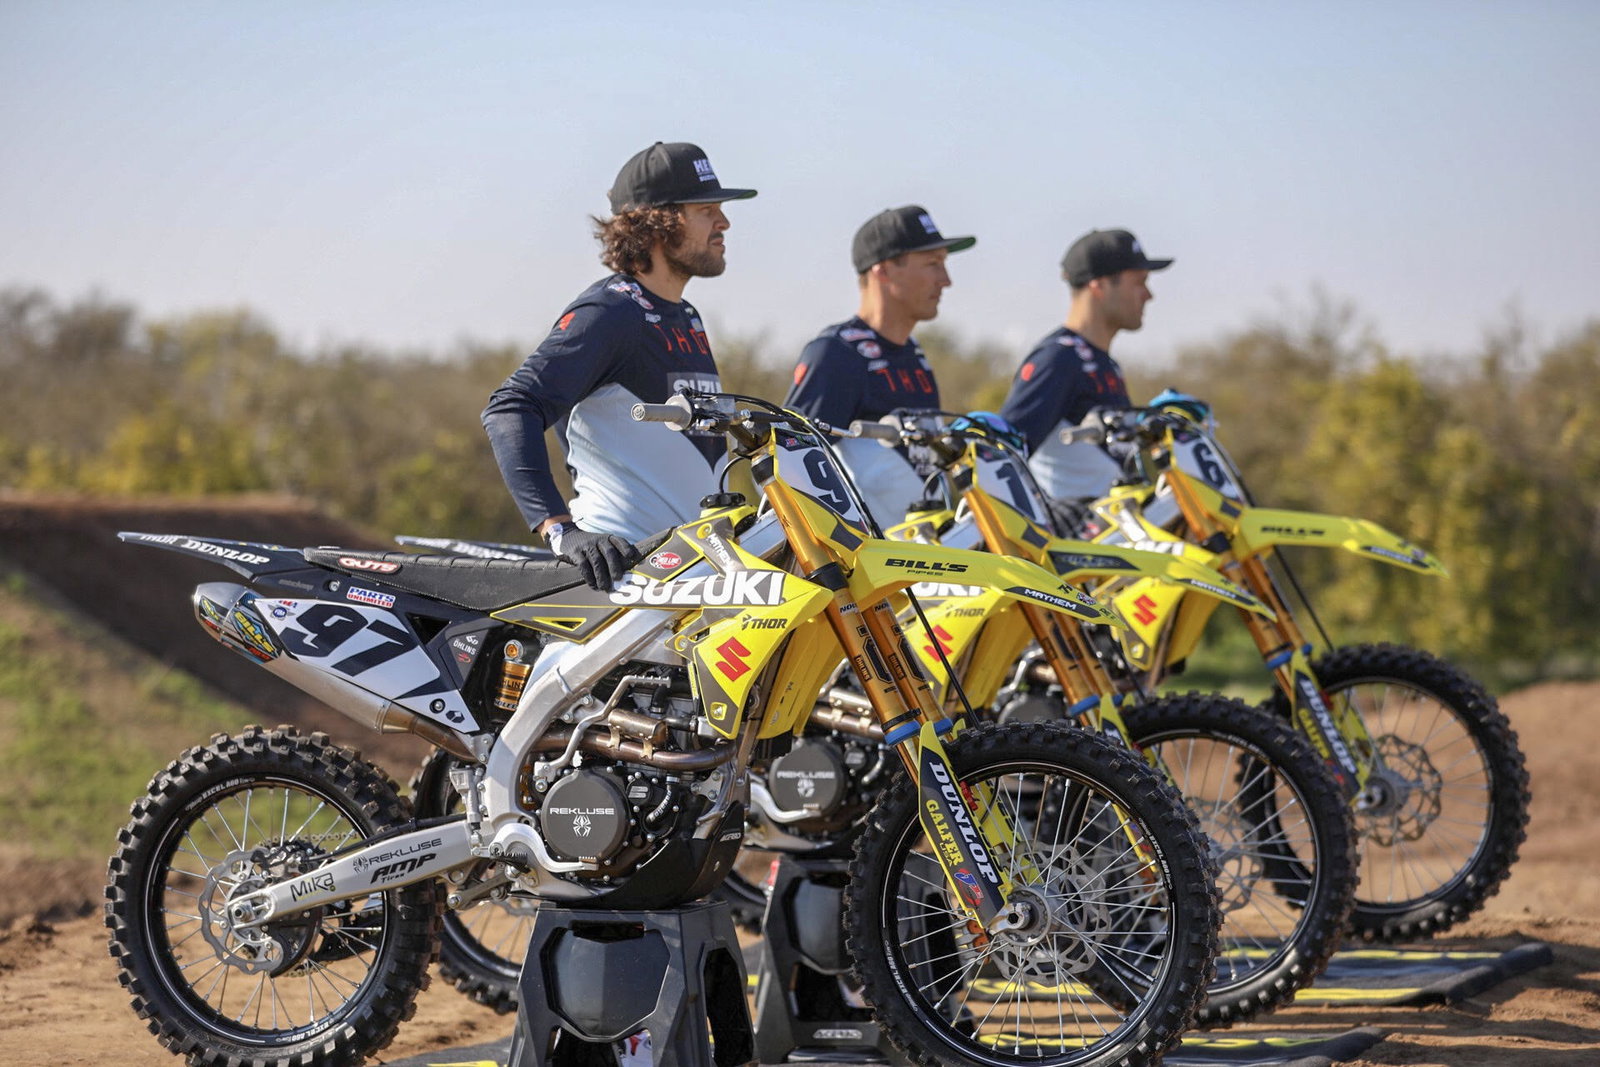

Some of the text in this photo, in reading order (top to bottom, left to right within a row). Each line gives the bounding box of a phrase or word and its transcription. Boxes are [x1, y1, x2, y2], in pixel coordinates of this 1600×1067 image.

[181, 540, 270, 564] DUNLOP
[884, 558, 969, 572] BILL'S
[347, 594, 392, 607] UNLIMITED
[349, 587, 395, 603] PARTS
[608, 571, 785, 605] SUZUKI
[1024, 588, 1077, 610] MAYHEM
[751, 618, 788, 630] THOR
[280, 603, 413, 677] 97
[926, 799, 965, 866] GALFER
[929, 761, 998, 883] DUNLOP
[368, 838, 442, 866] REKLUSE
[370, 853, 437, 884] AMP
